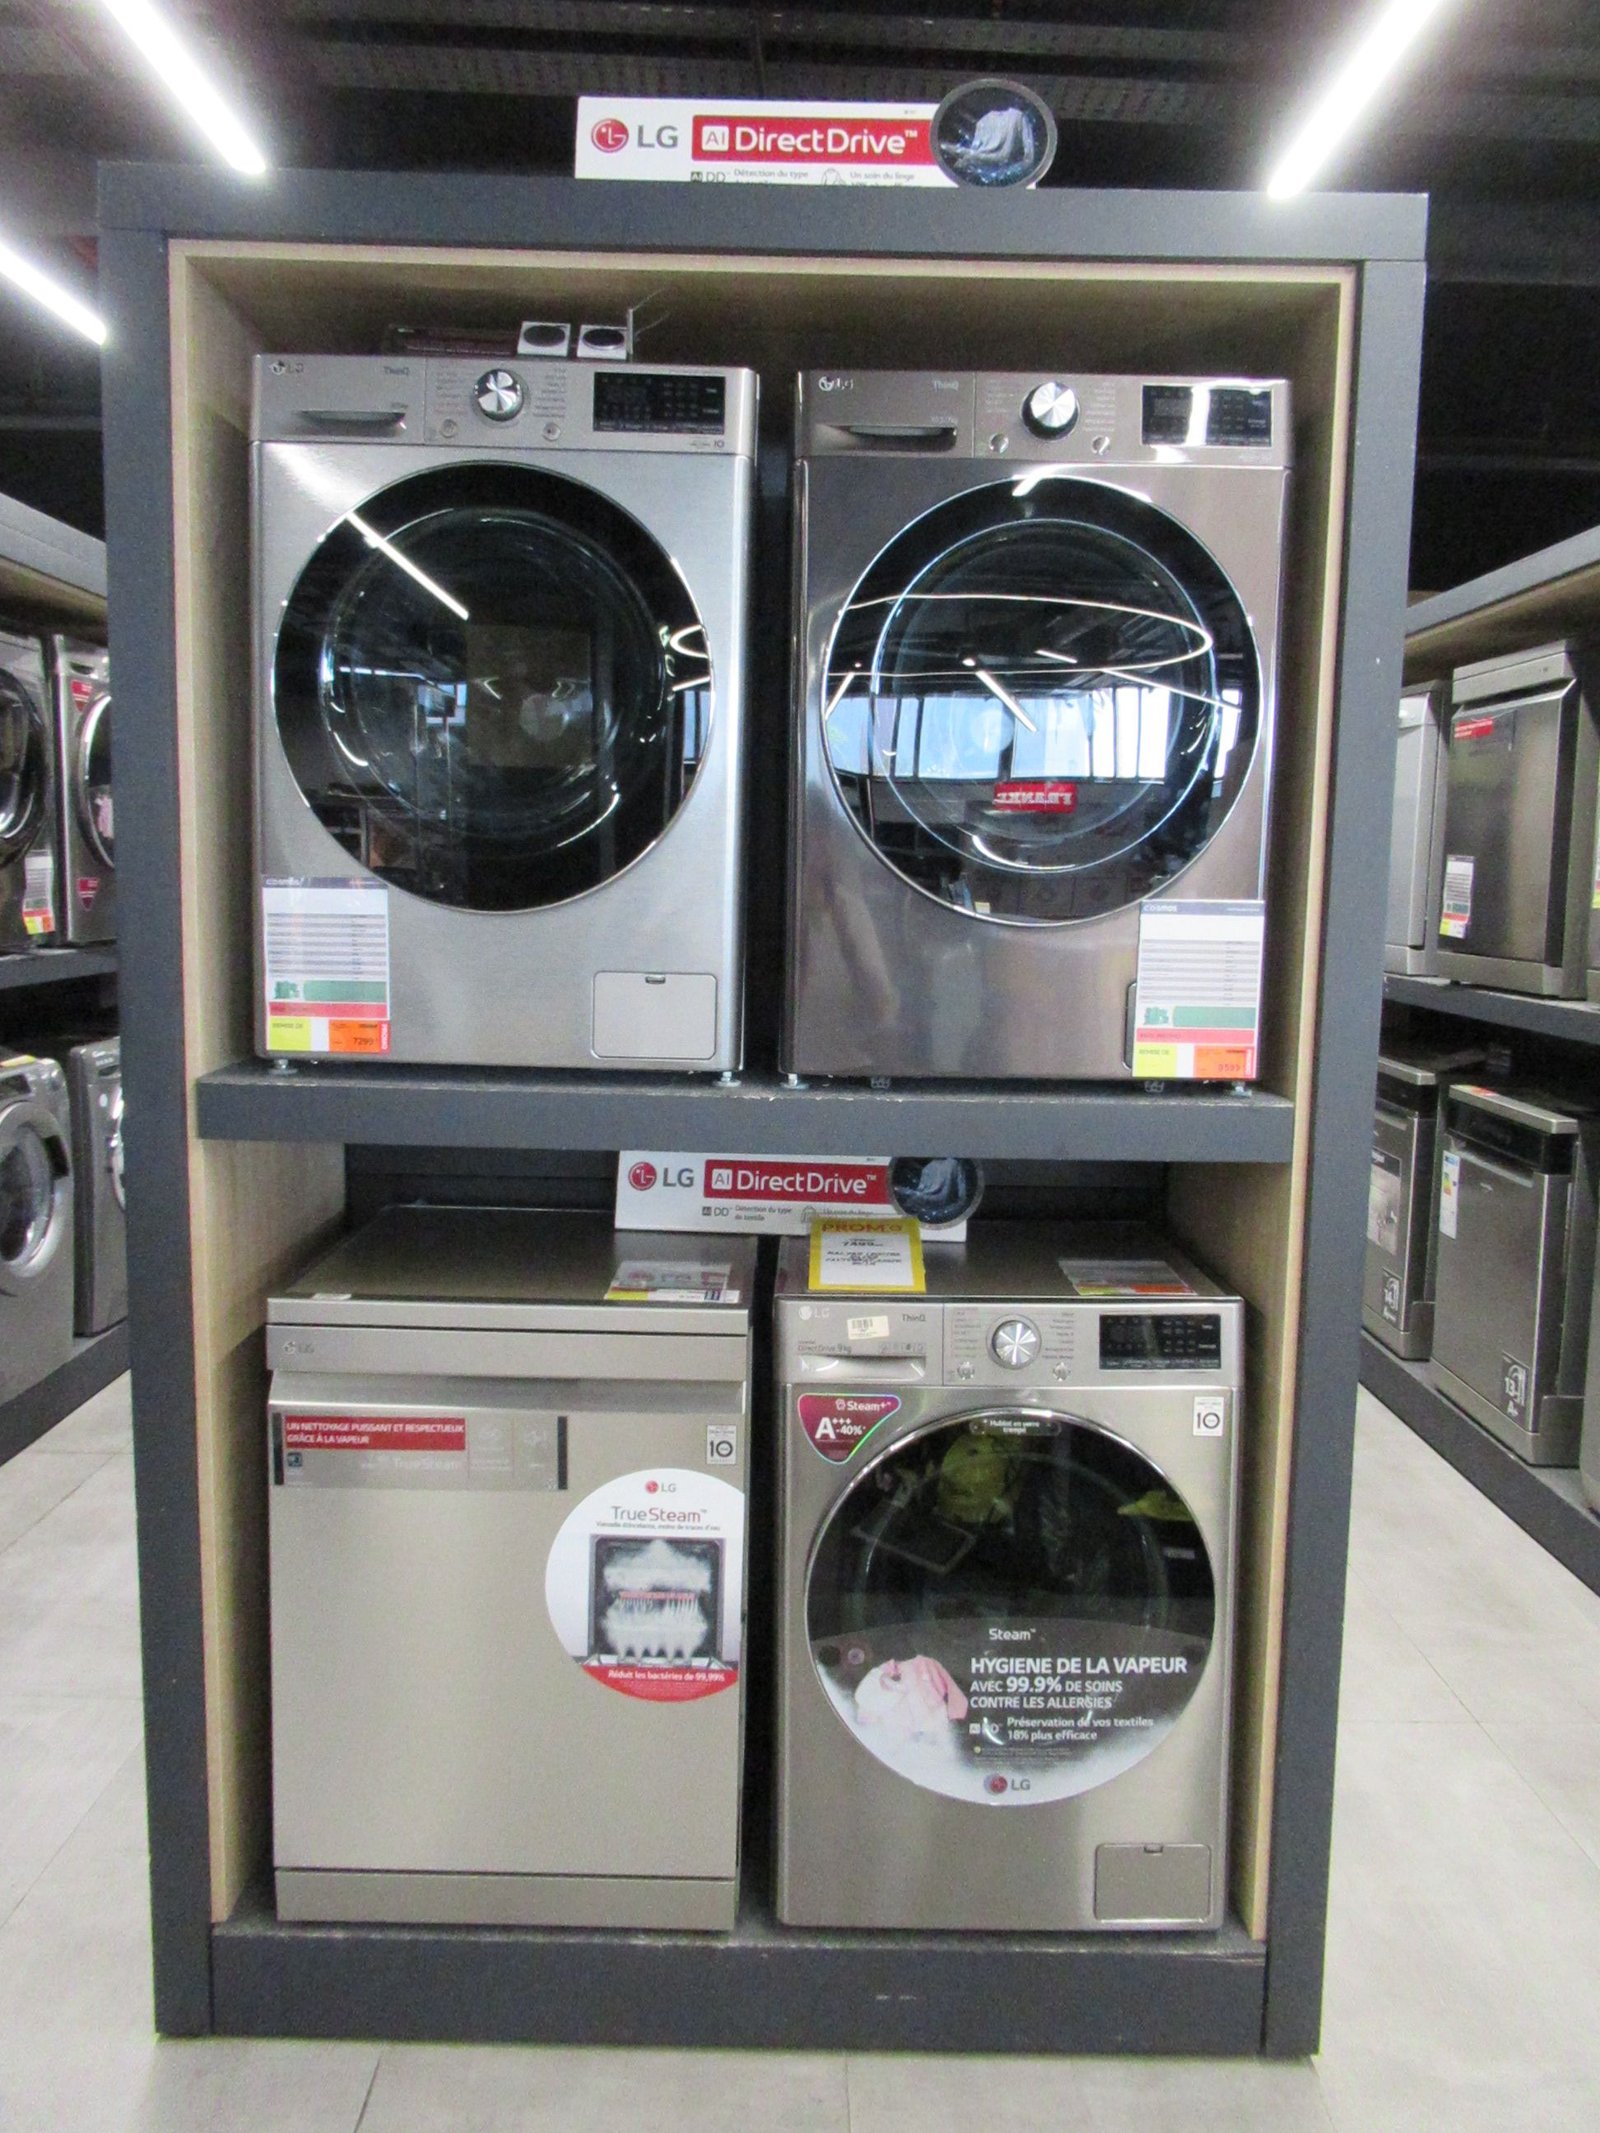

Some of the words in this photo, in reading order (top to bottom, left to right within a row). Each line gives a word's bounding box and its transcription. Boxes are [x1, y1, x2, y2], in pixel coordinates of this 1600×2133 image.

[637, 125, 678, 149] LG
[705, 131, 726, 146] AI
[777, 170, 788, 178] du
[790, 171, 809, 180] type
[882, 172, 894, 180] du
[662, 1167, 695, 1188] LG
[714, 1173, 730, 1185] AI
[822, 1223, 903, 1233] PROMO
[286, 1423, 300, 1431] UN
[301, 1423, 350, 1431] NETTOYAGE
[351, 1423, 392, 1432] PUISSANT
[393, 1424, 403, 1432] ET
[405, 1424, 465, 1433] RESPECTUEUX
[287, 1433, 315, 1443] GRÂCE
[324, 1435, 335, 1443] LA
[336, 1436, 370, 1444] VAPEUR
[660, 1483, 677, 1493] LG
[970, 1657, 1052, 1674] HYGIENE
[1056, 1657, 1081, 1674] DE
[1086, 1657, 1110, 1674] LA
[1113, 1657, 1187, 1675] VAPEUR
[608, 1669, 634, 1678] Réduit
[635, 1670, 646, 1679] les
[647, 1671, 683, 1680] bactéries
[684, 1671, 694, 1680] de
[970, 1681, 1004, 1693] AVEC
[1006, 1676, 1061, 1693] 99.9%
[1065, 1681, 1082, 1693] DE
[1085, 1681, 1123, 1693] SOINS
[970, 1697, 1020, 1709] CONTRE
[1023, 1697, 1045, 1709] LES
[1047, 1697, 1113, 1709] ALLERGIES
[1007, 1716, 1076, 1728] Préservation
[1077, 1717, 1089, 1728] de
[1092, 1718, 1111, 1728] vos
[1113, 1717, 1154, 1727] textiles
[1007, 1730, 1029, 1741] 18%
[1030, 1730, 1053, 1743] plus
[1055, 1730, 1098, 1740] efficace
[1010, 1778, 1031, 1792] LG
